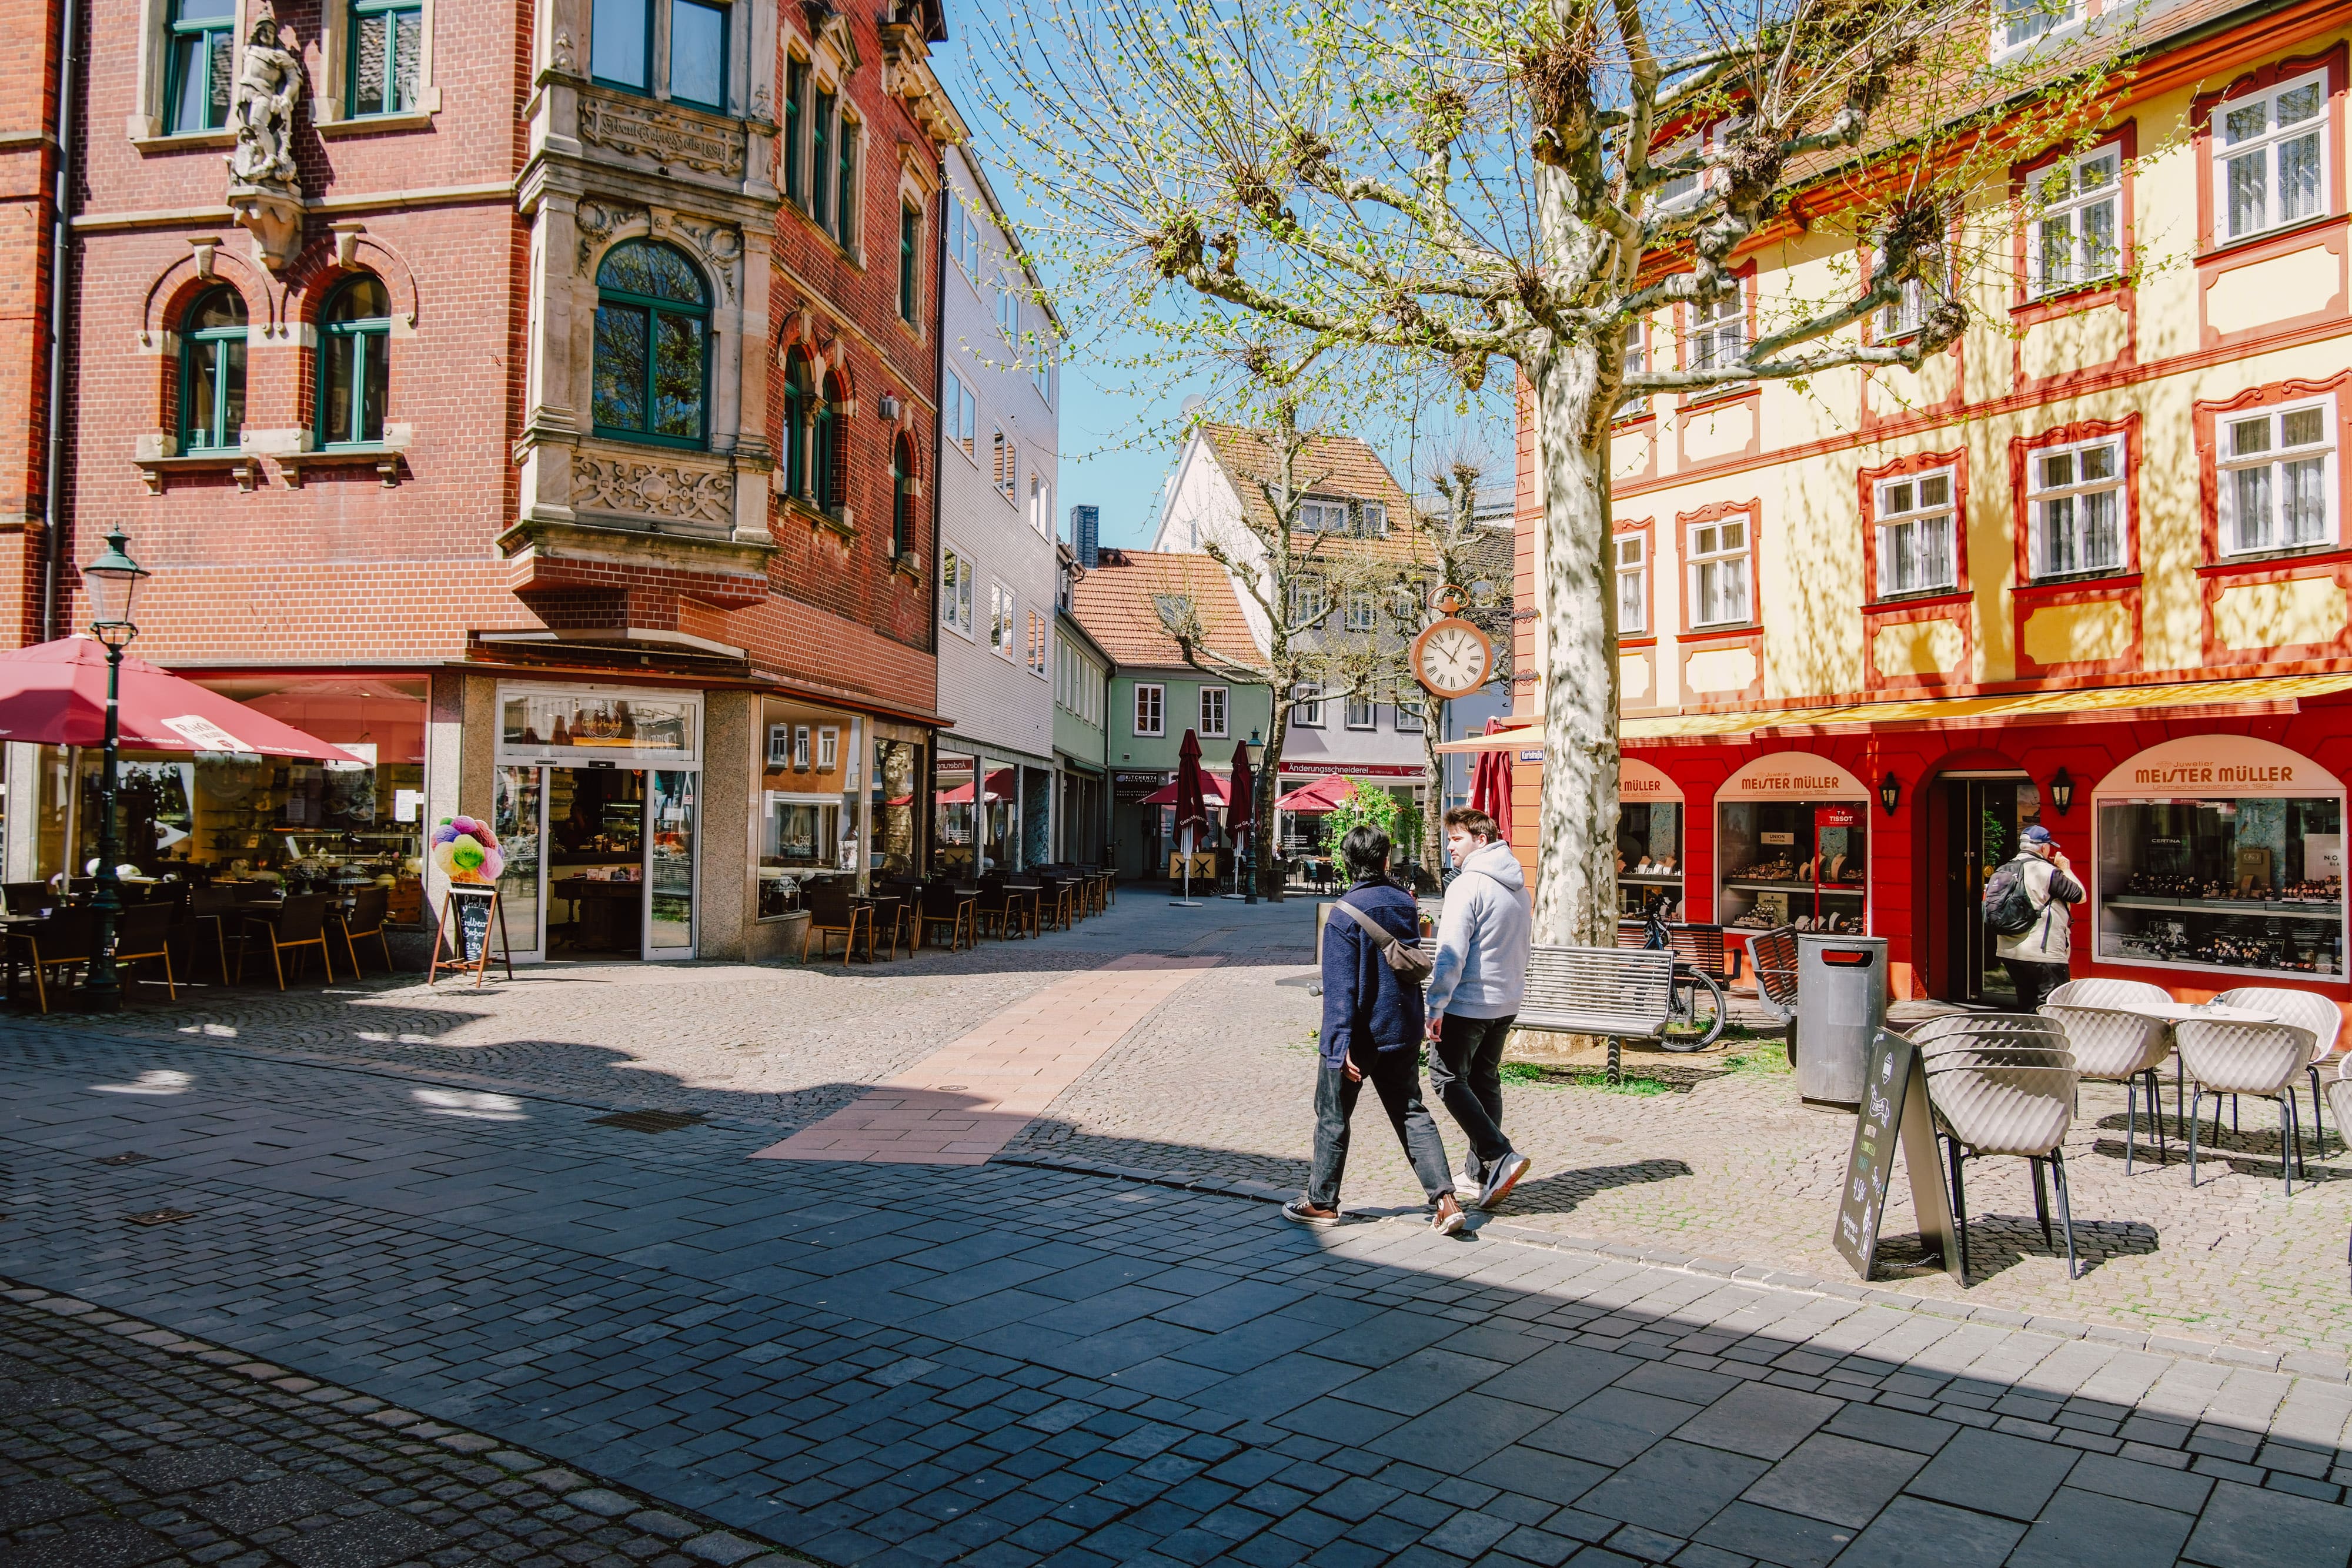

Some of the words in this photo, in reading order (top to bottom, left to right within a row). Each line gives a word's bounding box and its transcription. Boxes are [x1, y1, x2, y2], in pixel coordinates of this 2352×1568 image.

[176, 720, 216, 734] RHÖN
[142, 736, 185, 744] Genuss
[1522, 750, 1543, 760] Karlstraße
[1288, 763, 1369, 774] Änderungsschneiderei
[2219, 766, 2293, 782] MÜLLER
[1624, 780, 1661, 791] MÜLLER
[1793, 775, 1839, 788] MÜLLER
[1180, 814, 1197, 825] Genuss
[463, 927, 486, 940] Becher
